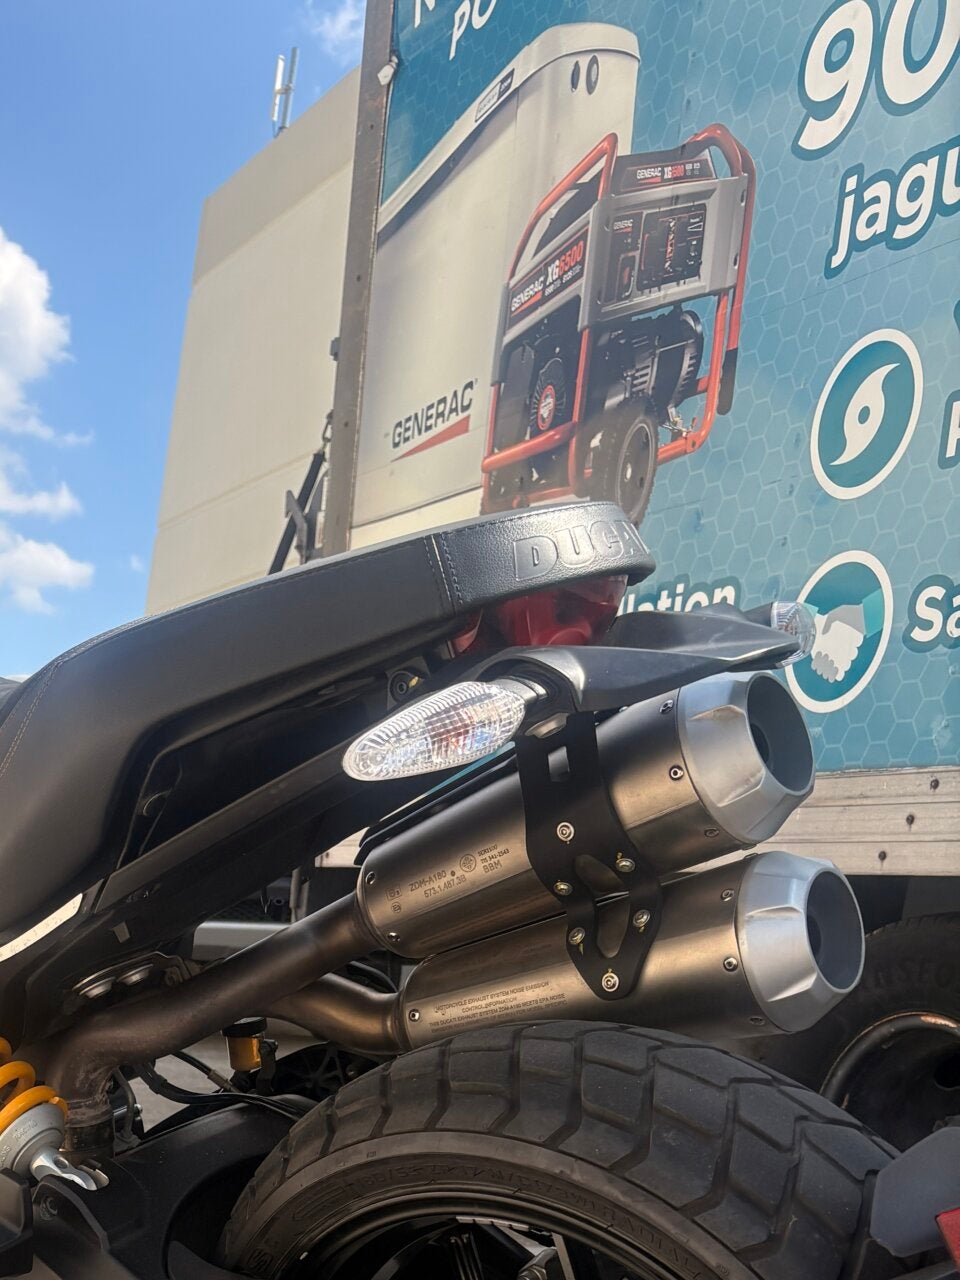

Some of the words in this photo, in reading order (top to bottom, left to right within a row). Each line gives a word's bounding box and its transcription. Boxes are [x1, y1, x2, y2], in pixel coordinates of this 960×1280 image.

[637, 167, 661, 180] GENERAC
[511, 275, 545, 312] GENERAC
[391, 380, 474, 449] GENERAC
[467, 994, 490, 1005] EXHAUST
[489, 990, 509, 1000] SYSTEM
